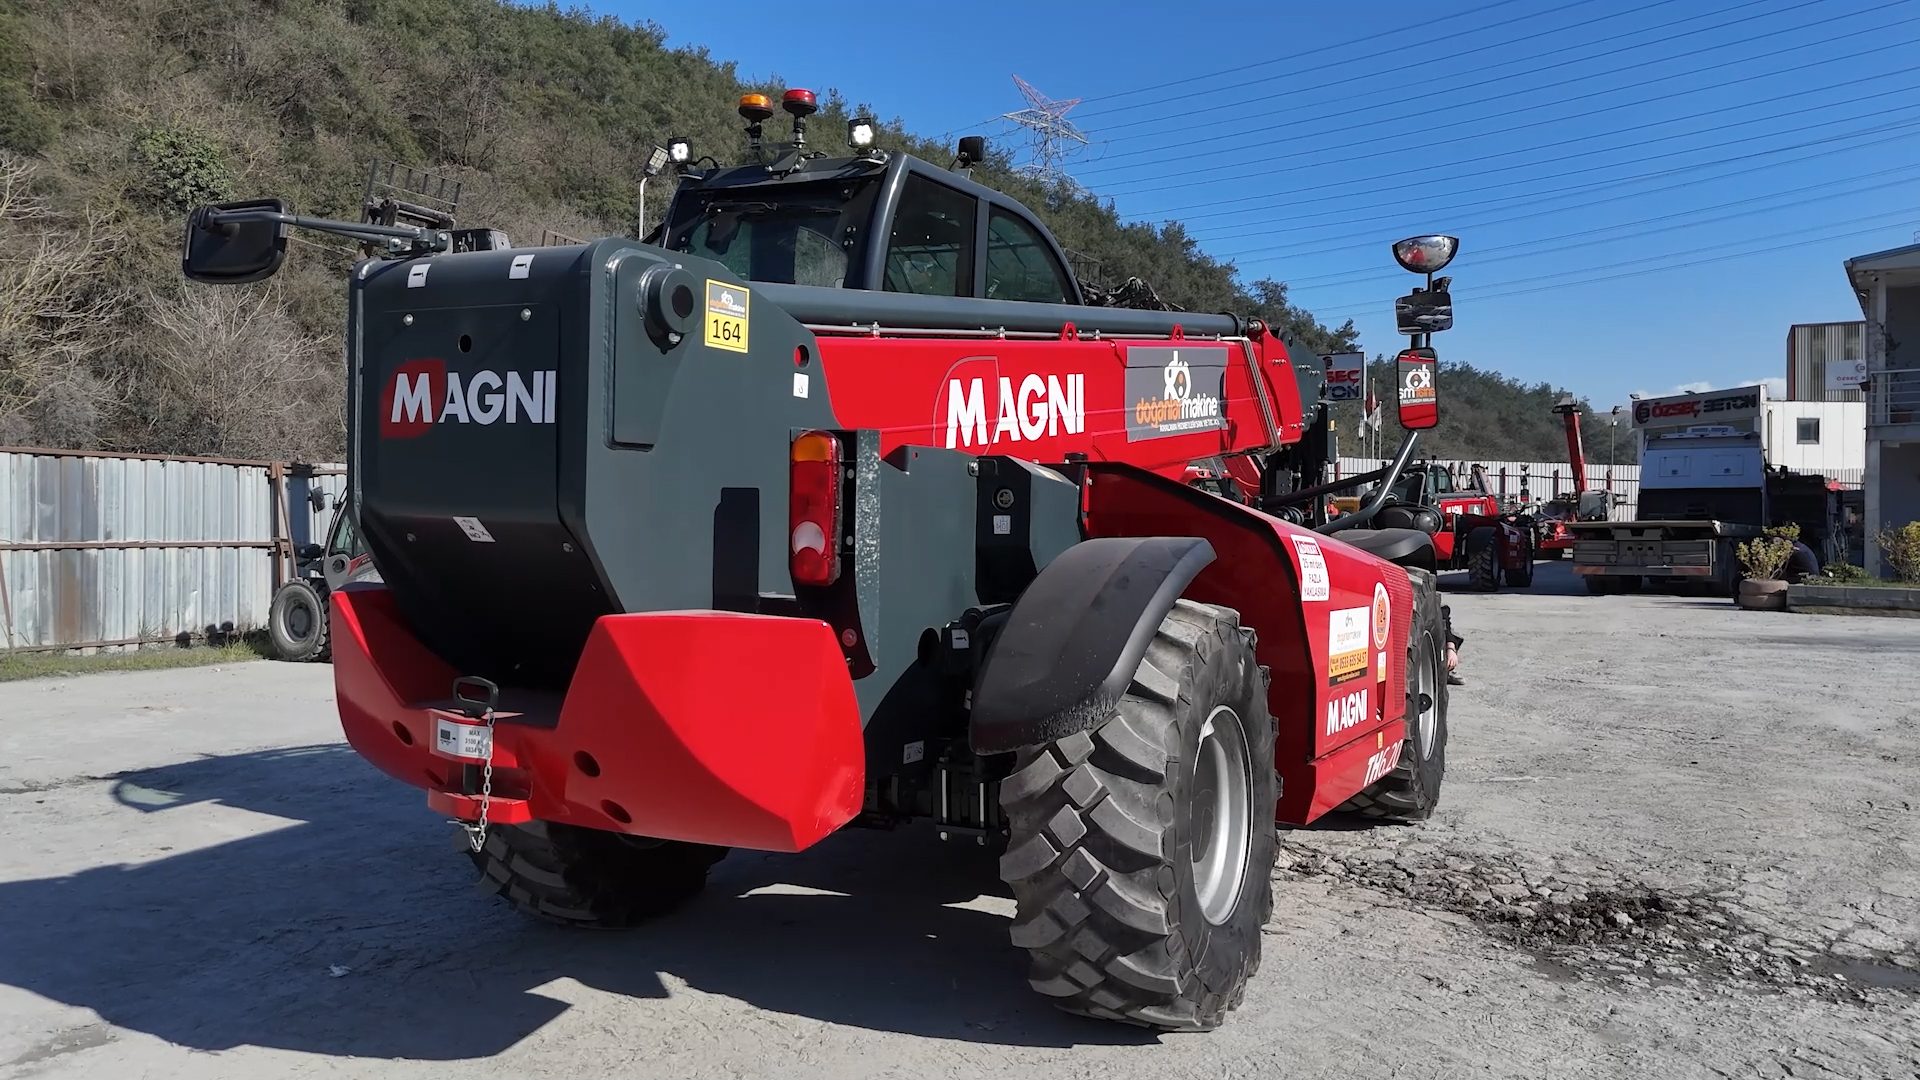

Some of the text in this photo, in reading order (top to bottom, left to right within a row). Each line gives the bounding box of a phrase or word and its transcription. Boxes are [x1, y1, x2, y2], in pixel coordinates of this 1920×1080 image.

[712, 318, 741, 343] 164
[1326, 369, 1361, 386] SEÇ
[390, 369, 557, 426] MAGNI
[945, 373, 1085, 449] MAGNI
[1326, 688, 1368, 737] MAGNI
[468, 729, 480, 737] MAX
